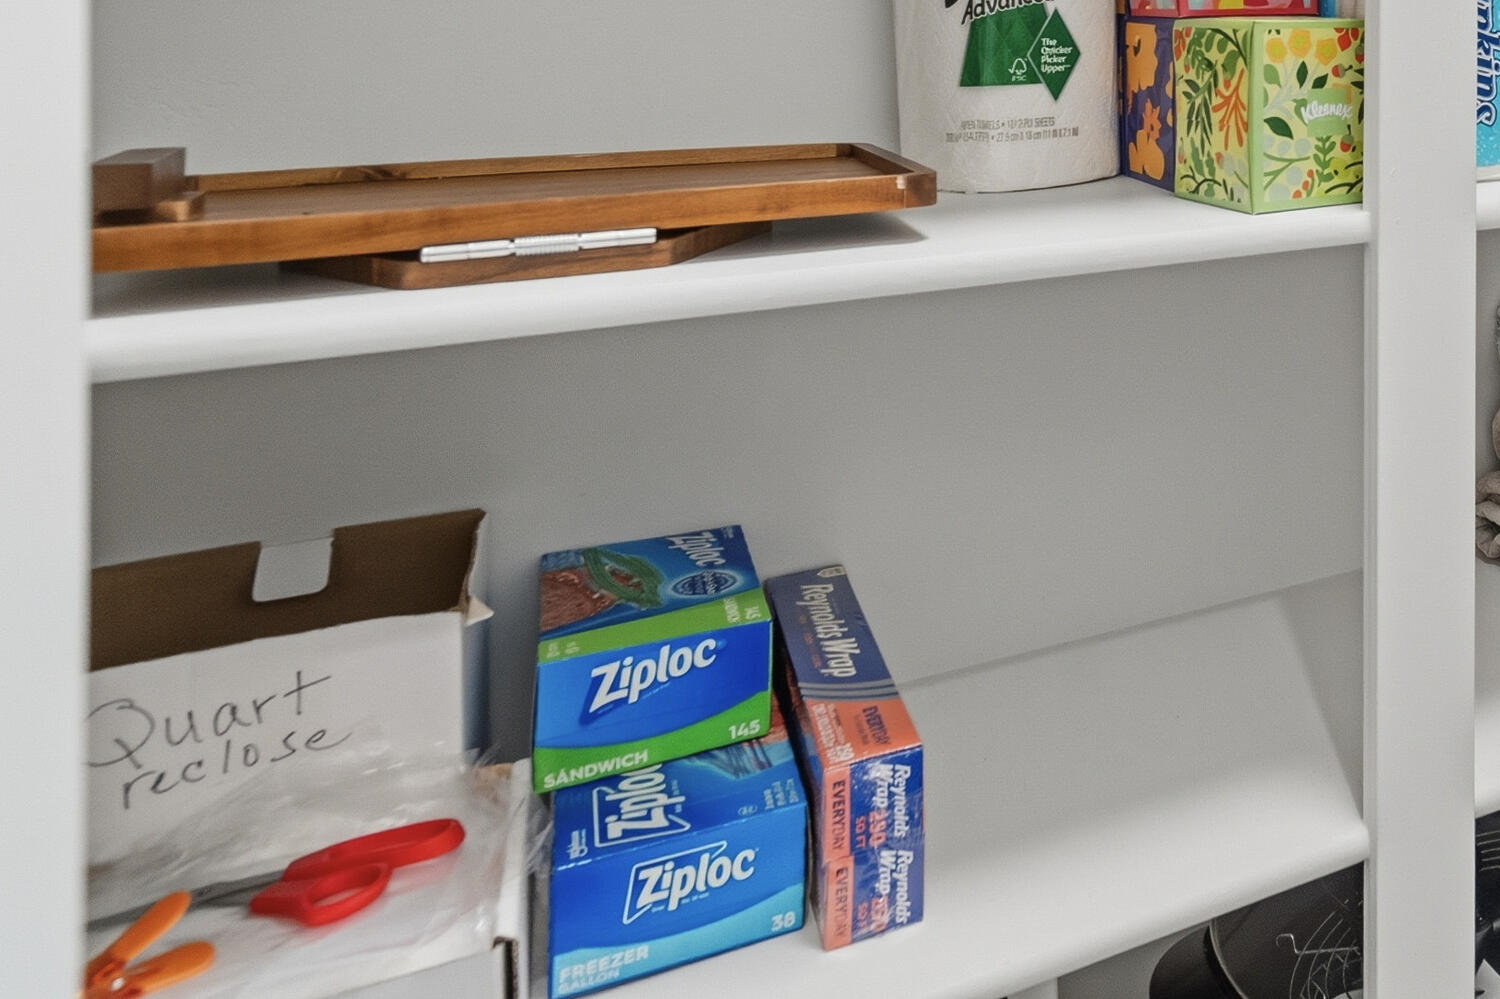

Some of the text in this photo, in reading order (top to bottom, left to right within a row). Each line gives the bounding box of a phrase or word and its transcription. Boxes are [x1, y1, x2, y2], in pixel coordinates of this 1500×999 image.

[1300, 101, 1352, 124] Kleenex
[664, 531, 727, 567] Ziploc
[795, 583, 849, 639] Reynolds
[588, 637, 717, 714] Ziploc
[819, 637, 861, 678] Wrap
[84, 669, 332, 770] Quart
[728, 719, 761, 740] 145
[121, 728, 354, 810] reclose
[543, 748, 649, 790] SANDWICH
[870, 763, 895, 810] Wrap
[831, 780, 846, 851] EVERYDAY
[890, 764, 912, 838] Reynolds
[636, 848, 756, 912] Ziploc
[875, 850, 897, 897] Wrap
[893, 850, 914, 925] Reynolds
[557, 967, 621, 995] GALLON
[558, 945, 650, 985] FREEZER
